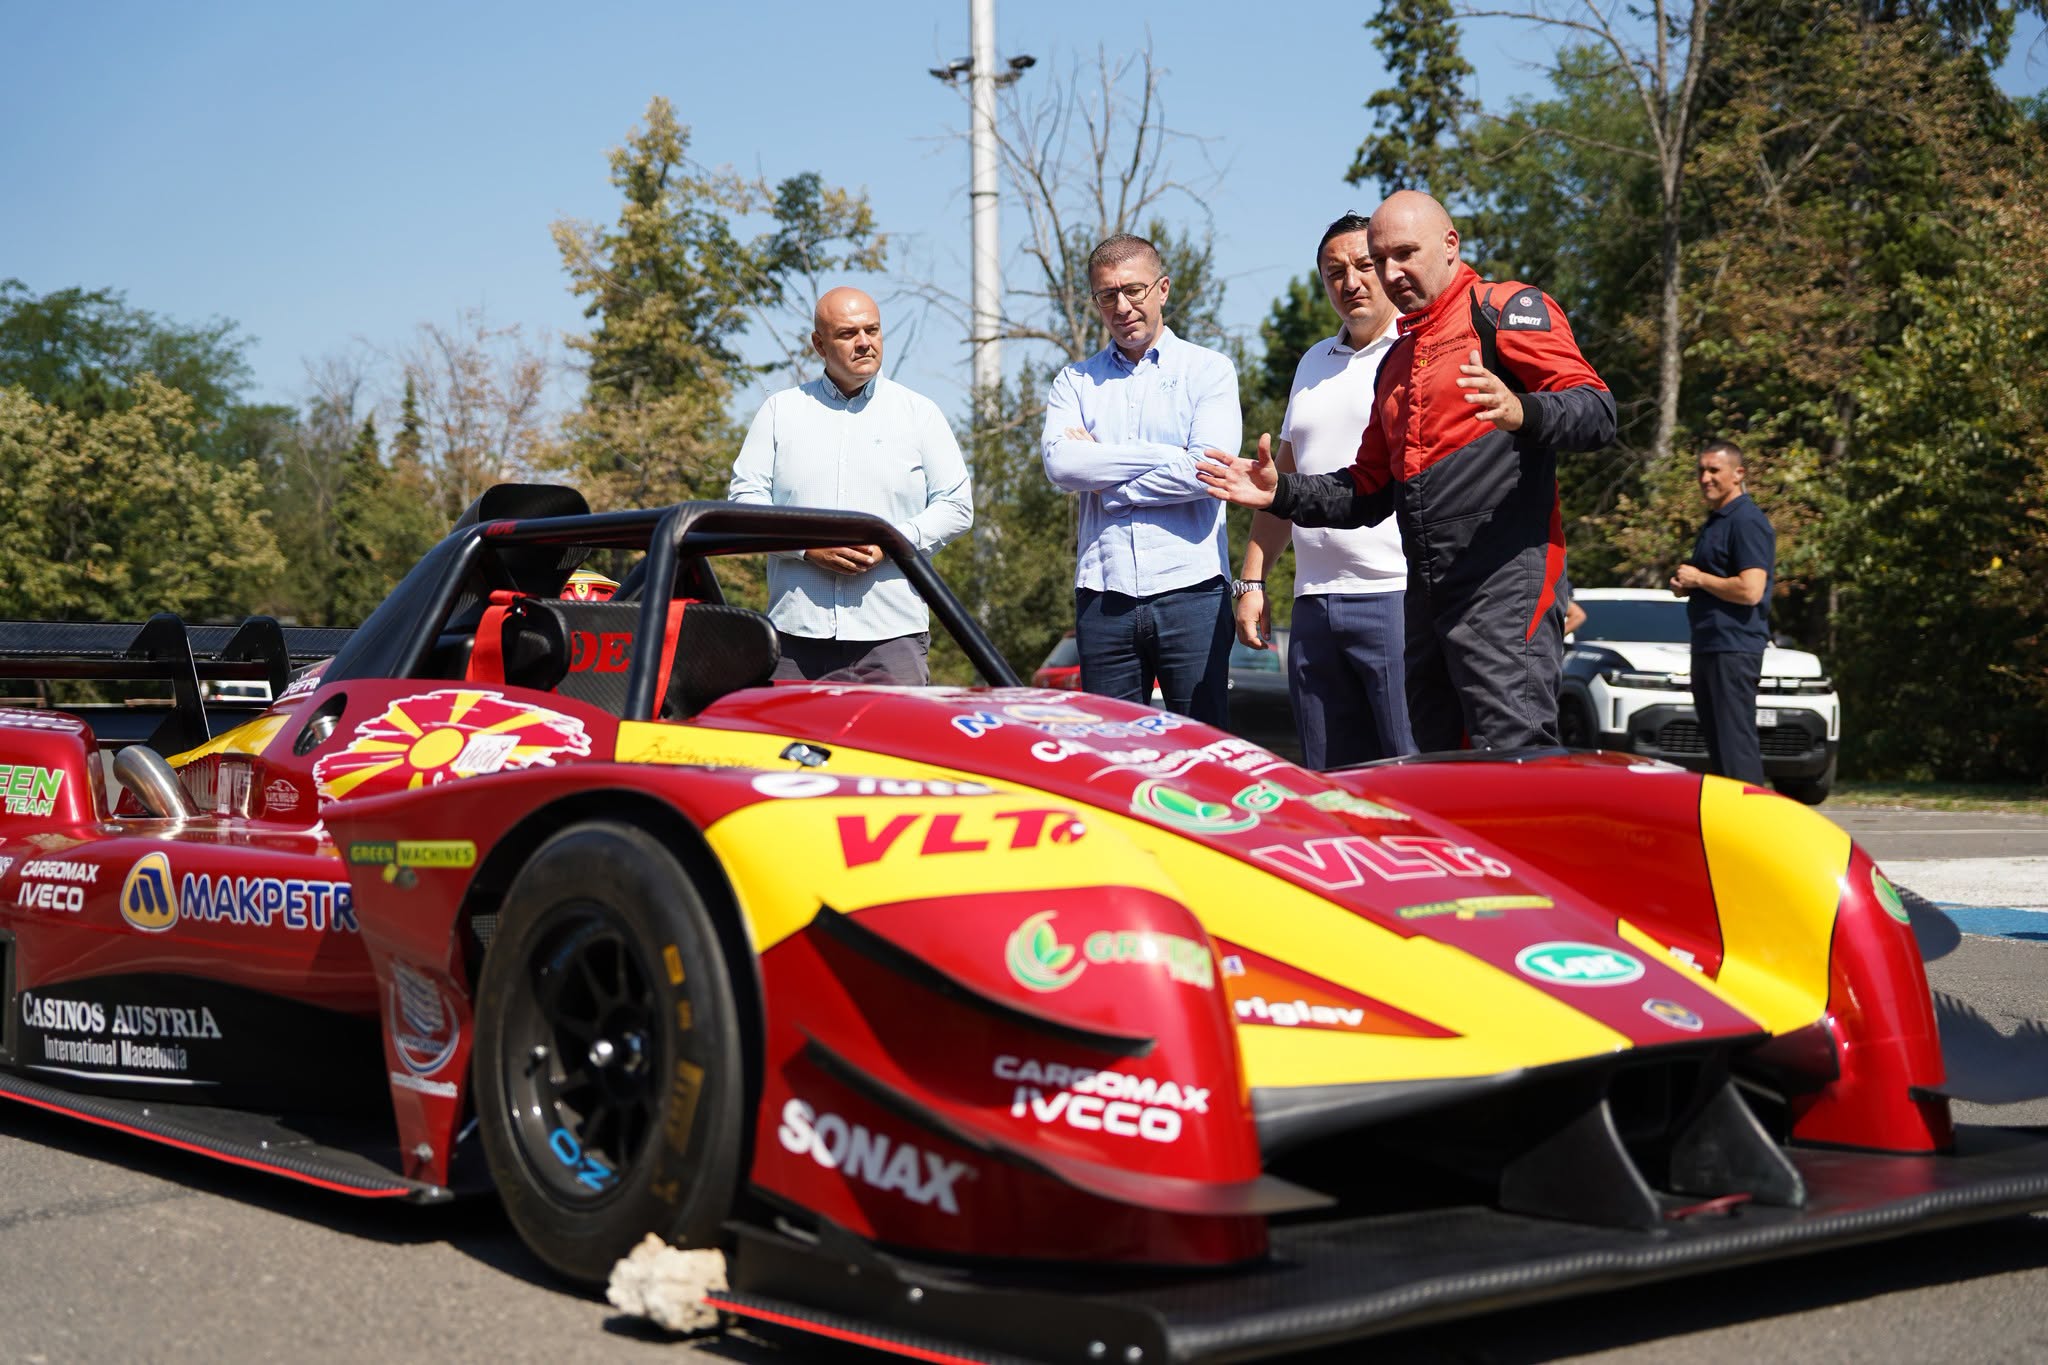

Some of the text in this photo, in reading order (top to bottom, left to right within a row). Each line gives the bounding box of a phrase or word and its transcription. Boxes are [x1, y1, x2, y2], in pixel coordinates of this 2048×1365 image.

[5, 798, 55, 817] TEAM
[350, 846, 395, 862] GREEN
[20, 860, 100, 882] CARGOMAX
[18, 882, 84, 912] IVECO
[22, 991, 222, 1038] CASINOS AUSTRIA
[44, 1034, 187, 1070] International Macedonia
[993, 1054, 1211, 1113] CARGOMAX
[778, 1098, 966, 1215] SONAX
